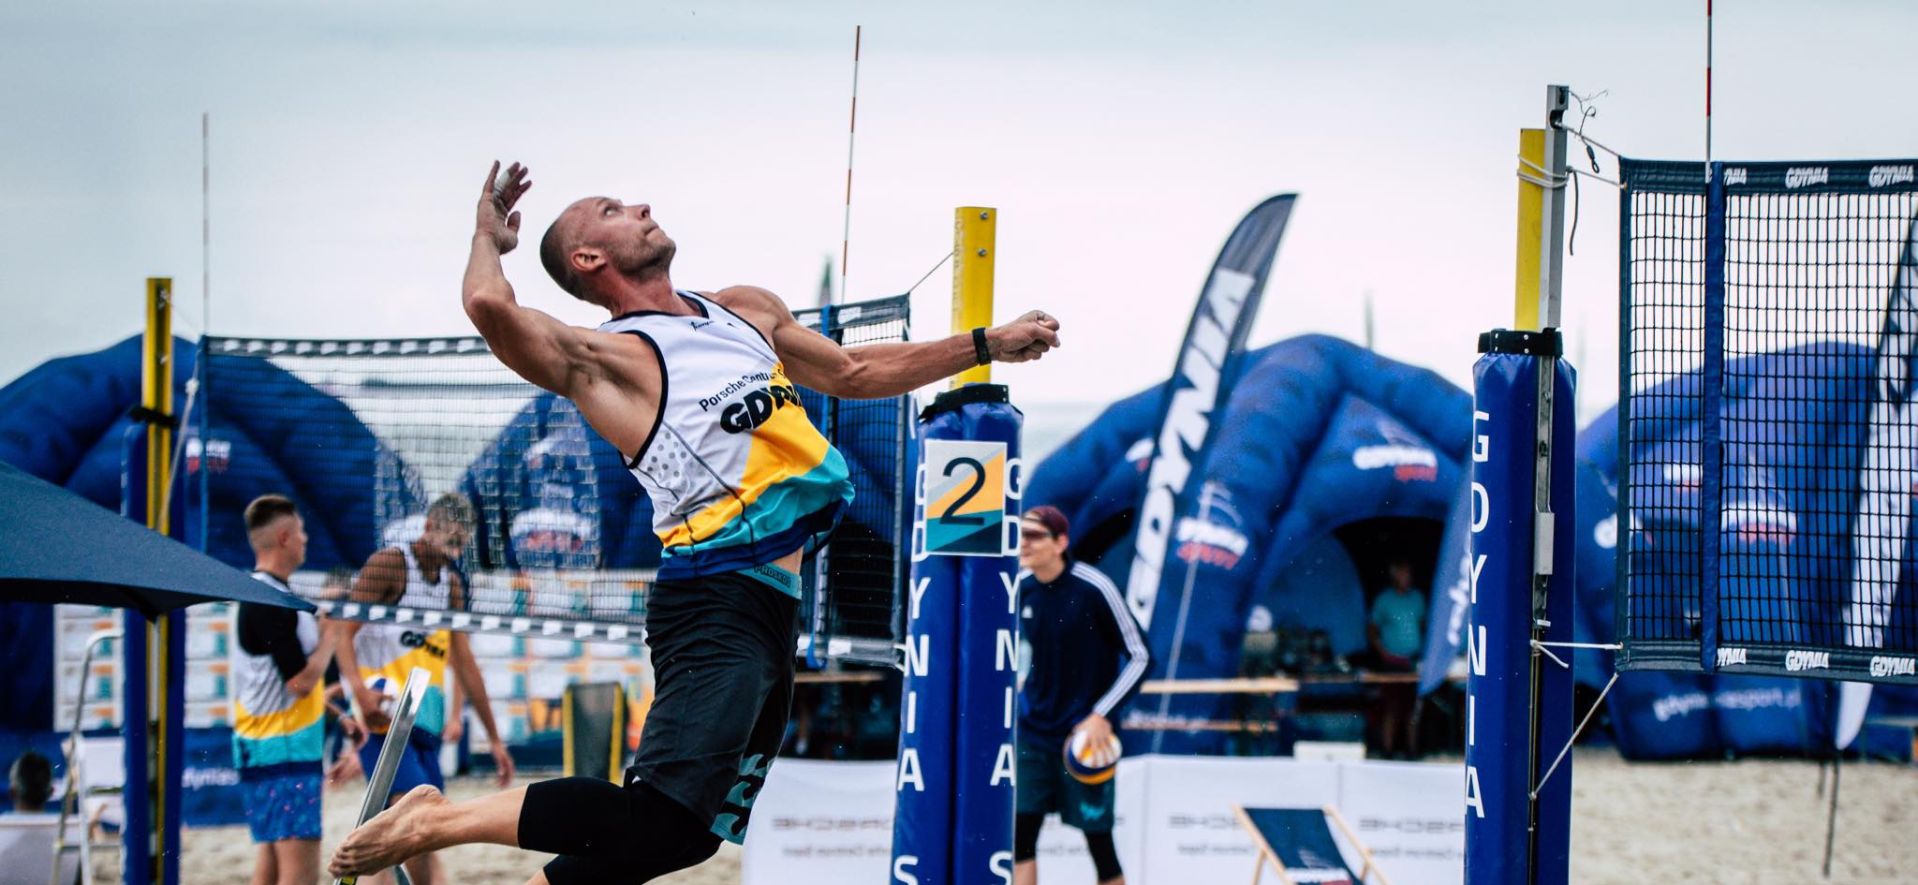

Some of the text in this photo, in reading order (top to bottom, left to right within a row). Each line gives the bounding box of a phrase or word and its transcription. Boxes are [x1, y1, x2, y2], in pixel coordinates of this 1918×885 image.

[1785, 166, 1828, 188] GDYNIA
[1868, 164, 1914, 187] GDYNIA
[699, 379, 746, 412] Porsche
[940, 457, 986, 526] 2
[1465, 411, 1490, 818] GDYNIA
[1717, 648, 1915, 677] YNIA GDYNIA GDYNIA
